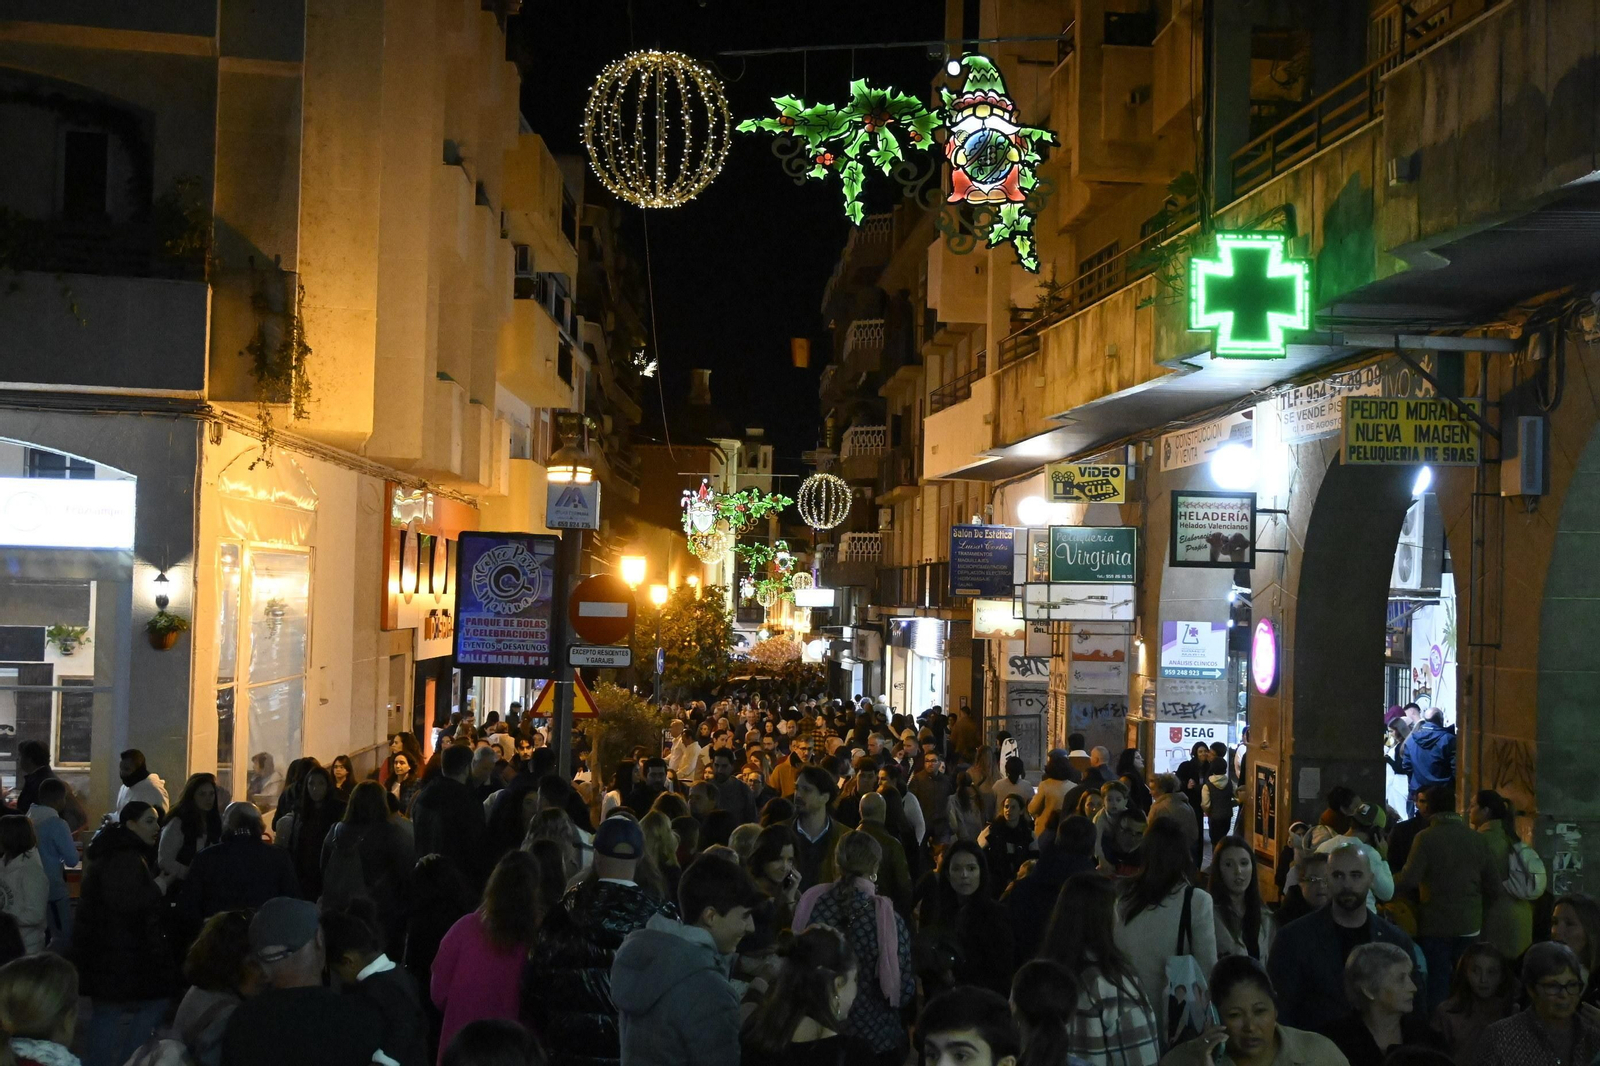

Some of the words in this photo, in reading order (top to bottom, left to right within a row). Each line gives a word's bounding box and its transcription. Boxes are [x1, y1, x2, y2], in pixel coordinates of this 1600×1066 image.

[1284, 411, 1295, 425] SE
[1296, 405, 1326, 421] VENDE
[1328, 400, 1342, 415] PIS
[1350, 400, 1399, 420] PEDRO
[1355, 423, 1402, 443] NUEVA
[1414, 424, 1470, 444] IMAGEN
[1348, 445, 1420, 463] PELUQUERIA
[1424, 446, 1439, 462] DE
[1084, 484, 1114, 496] CLUB
[1179, 510, 1249, 522] HELADERÍA
[1208, 522, 1248, 531] Valencianos
[1179, 531, 1213, 543] Elaboració
[1055, 542, 1132, 571] Virginia
[465, 617, 501, 627] PARQUE
[503, 618, 515, 627] DE
[516, 619, 547, 628] BOLAS
[465, 628, 471, 637] Y
[472, 628, 546, 639] CELEBRACIONES
[462, 641, 496, 649] EVENTOS
[502, 643, 547, 651] DESAYUNOS
[571, 648, 597, 656] EXCEPTO
[458, 653, 487, 663] CALLE
[1184, 727, 1214, 738] SEAG
